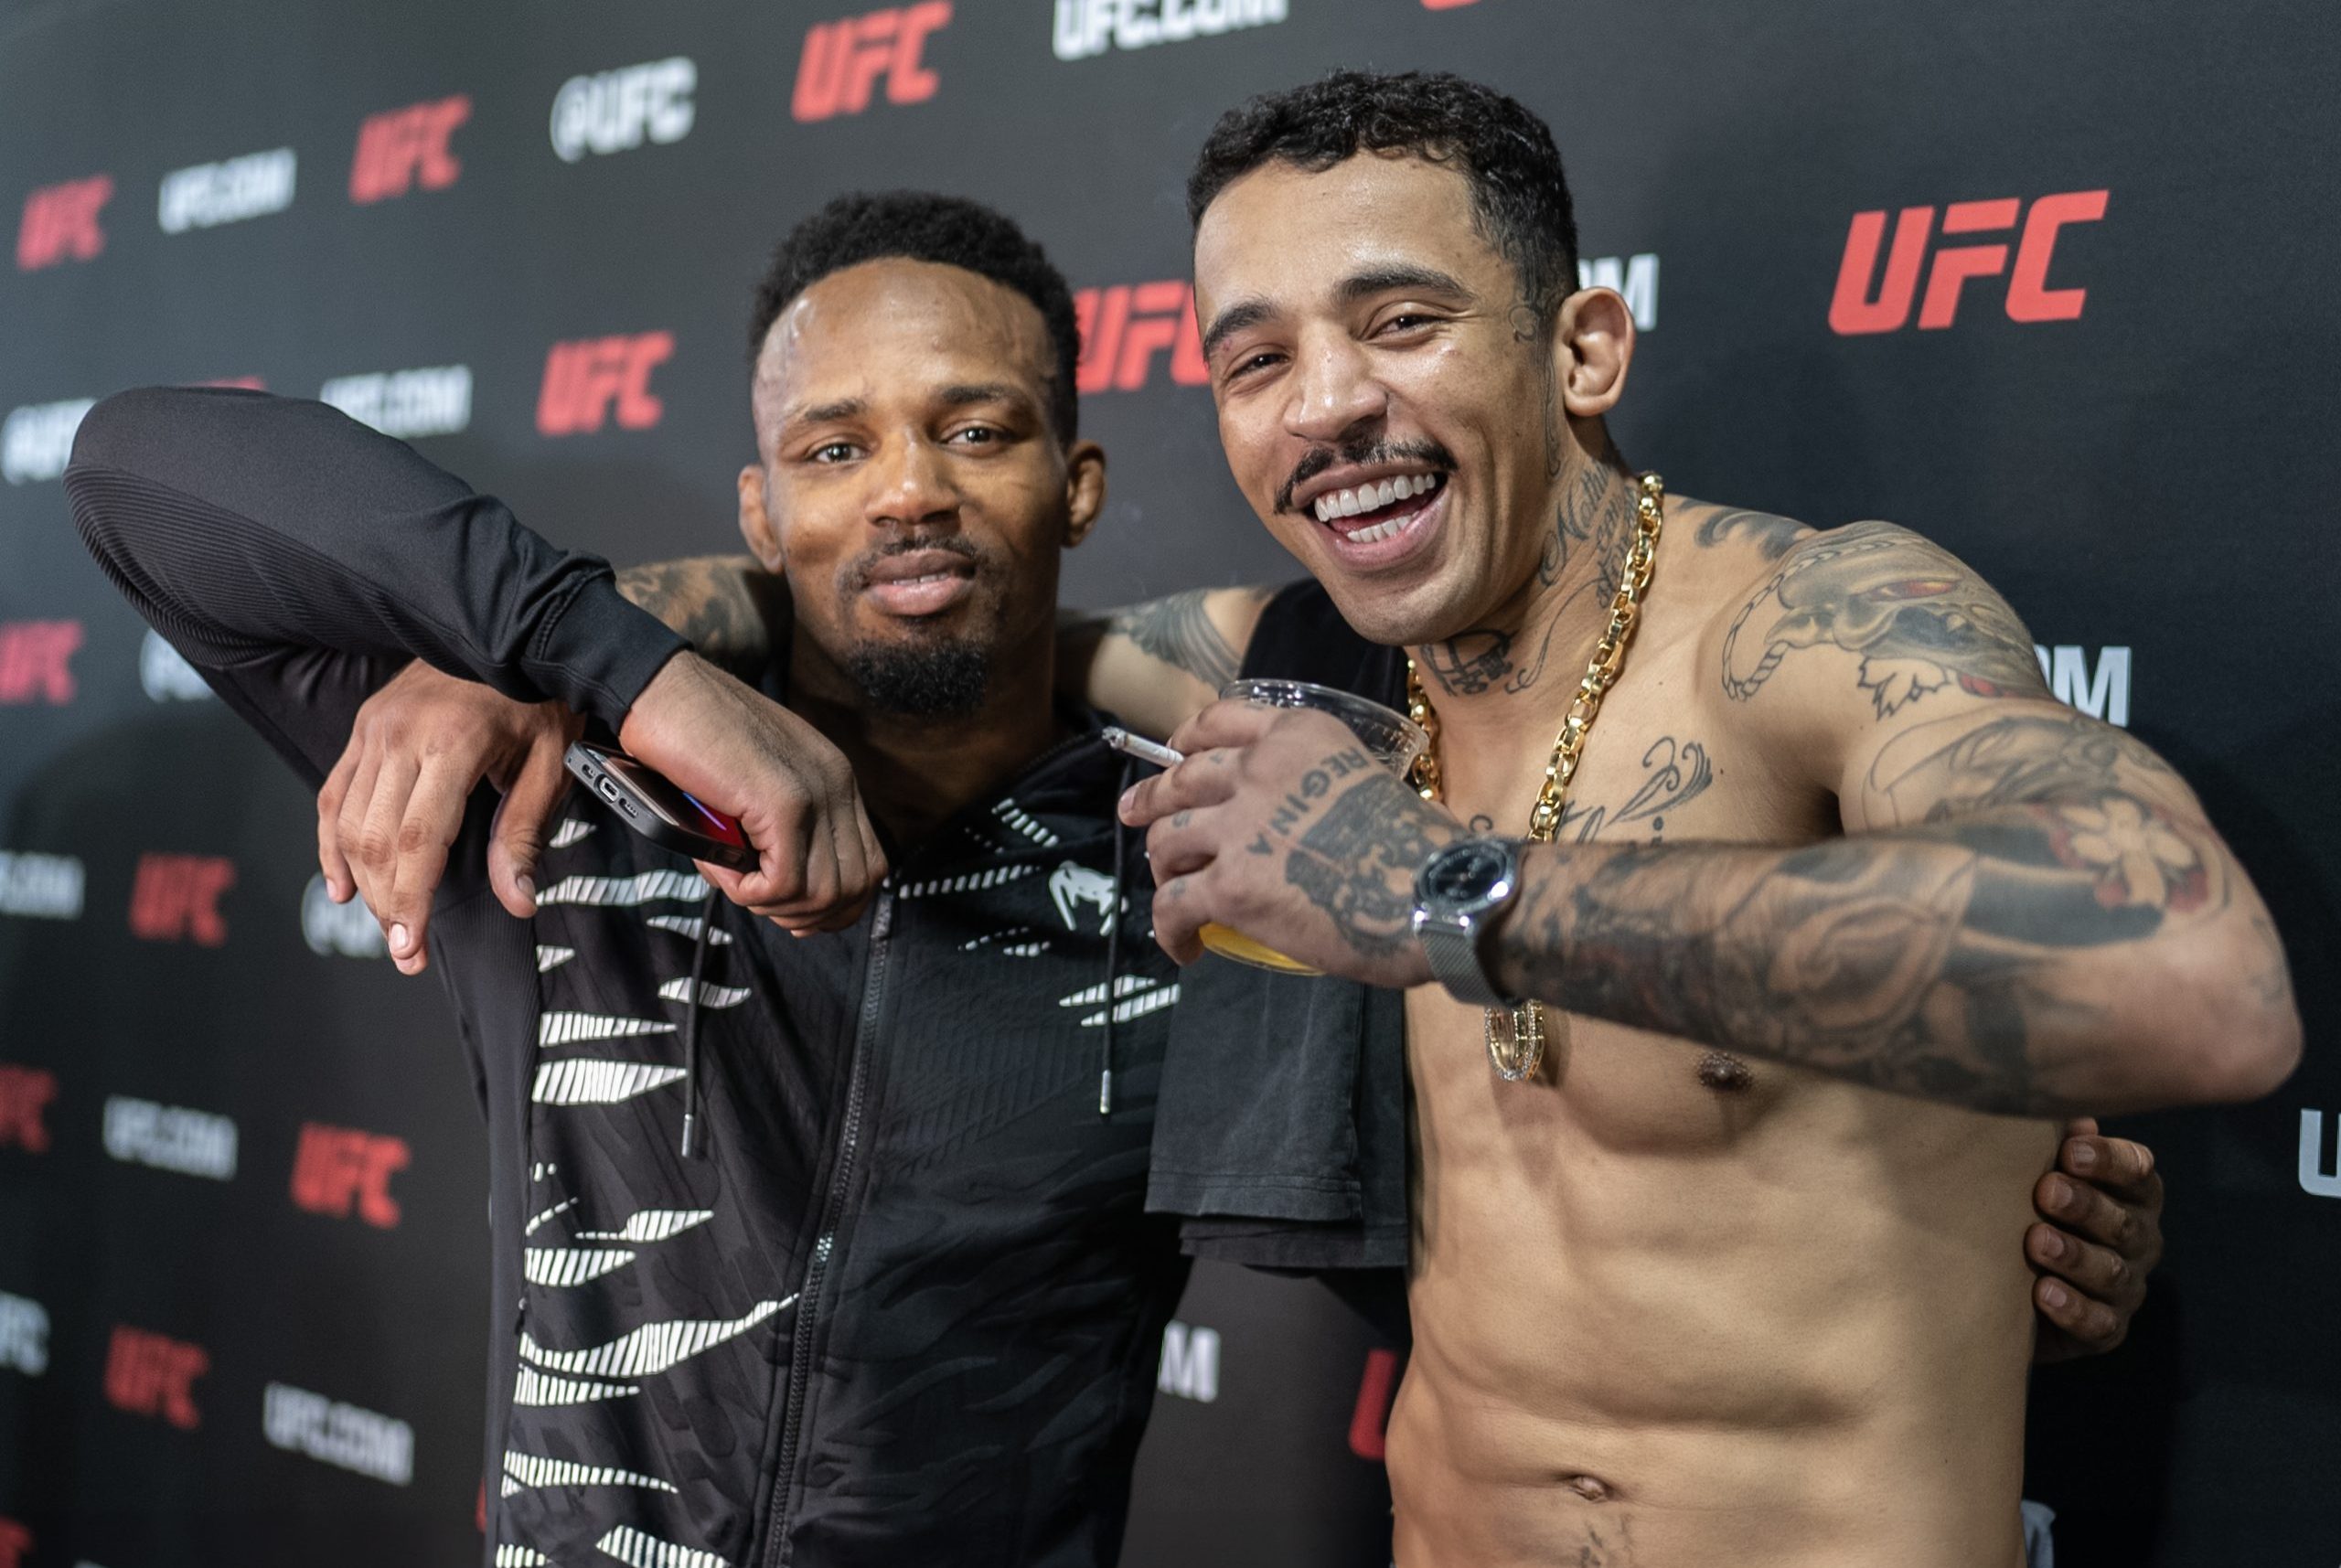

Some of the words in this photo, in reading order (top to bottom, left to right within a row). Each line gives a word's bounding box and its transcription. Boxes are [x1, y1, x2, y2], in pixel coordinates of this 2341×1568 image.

[551, 57, 696, 162] @UFC
[793, 0, 952, 121] UFC
[350, 95, 470, 202] UFC
[1829, 190, 2110, 336] UFC
[537, 331, 675, 435] UFC
[1245, 745, 1369, 858] REGINA
[291, 1125, 409, 1227] UFC
